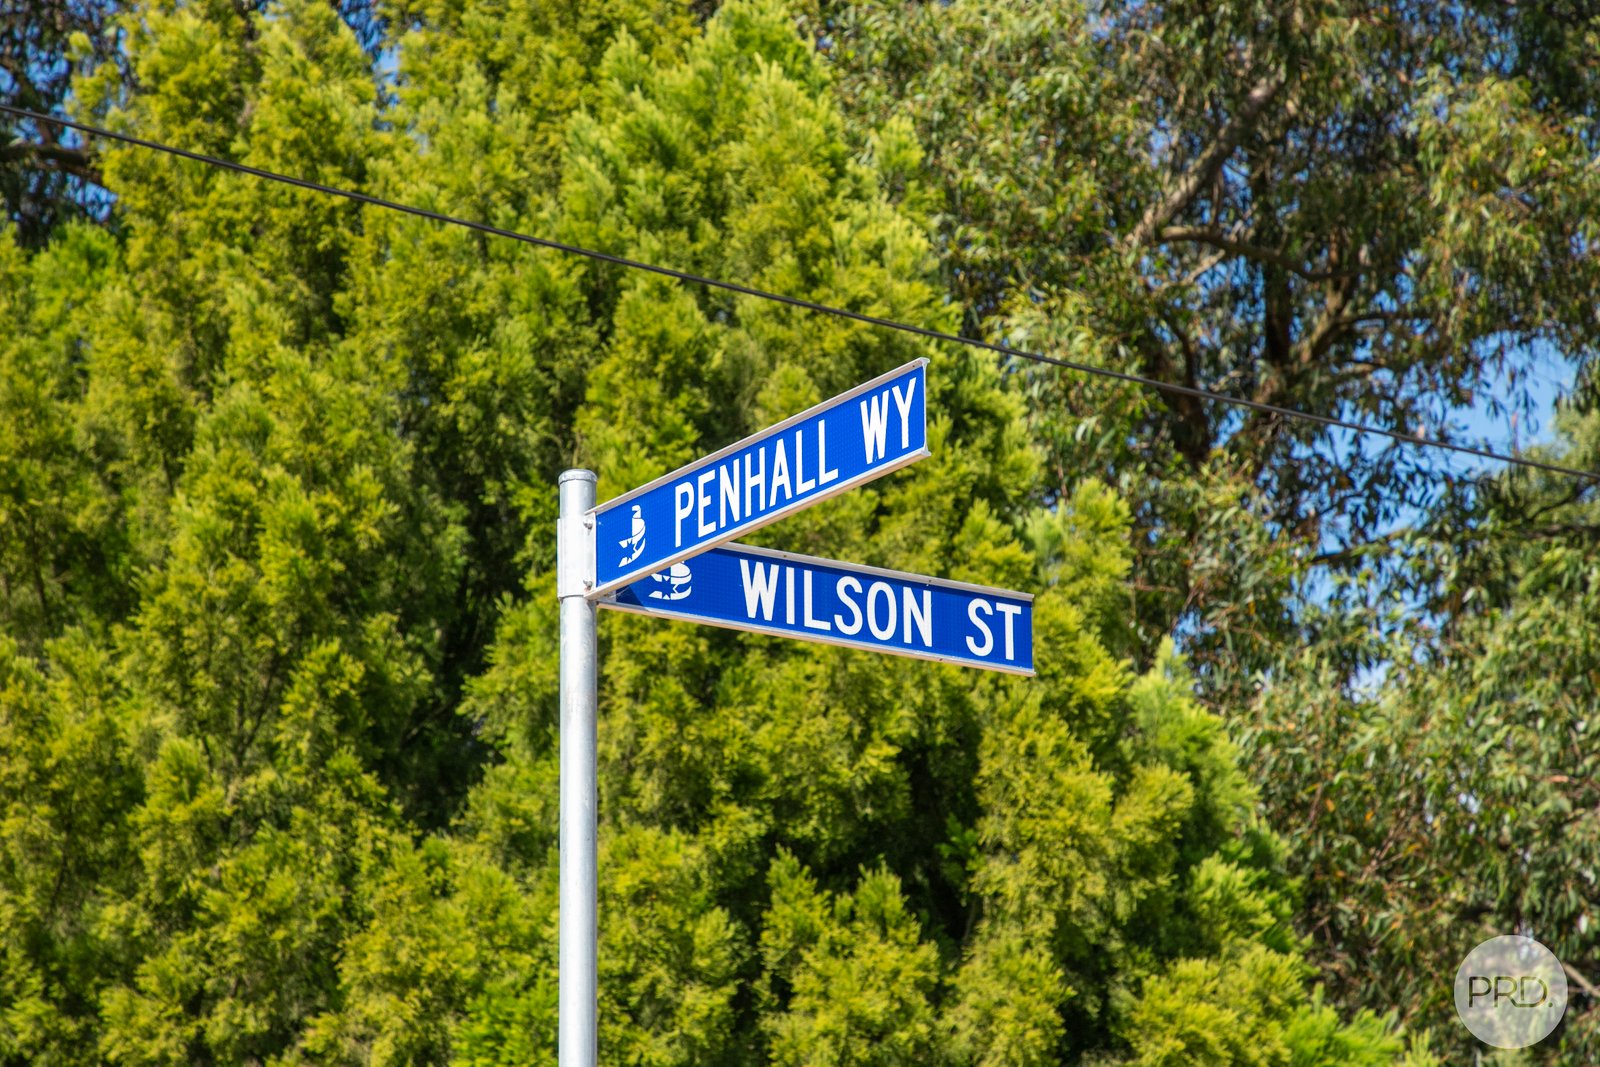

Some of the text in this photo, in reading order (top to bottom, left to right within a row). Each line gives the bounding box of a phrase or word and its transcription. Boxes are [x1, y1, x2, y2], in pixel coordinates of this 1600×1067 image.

[674, 377, 917, 548] PENHALL WY
[739, 558, 1022, 661] WILSON ST
